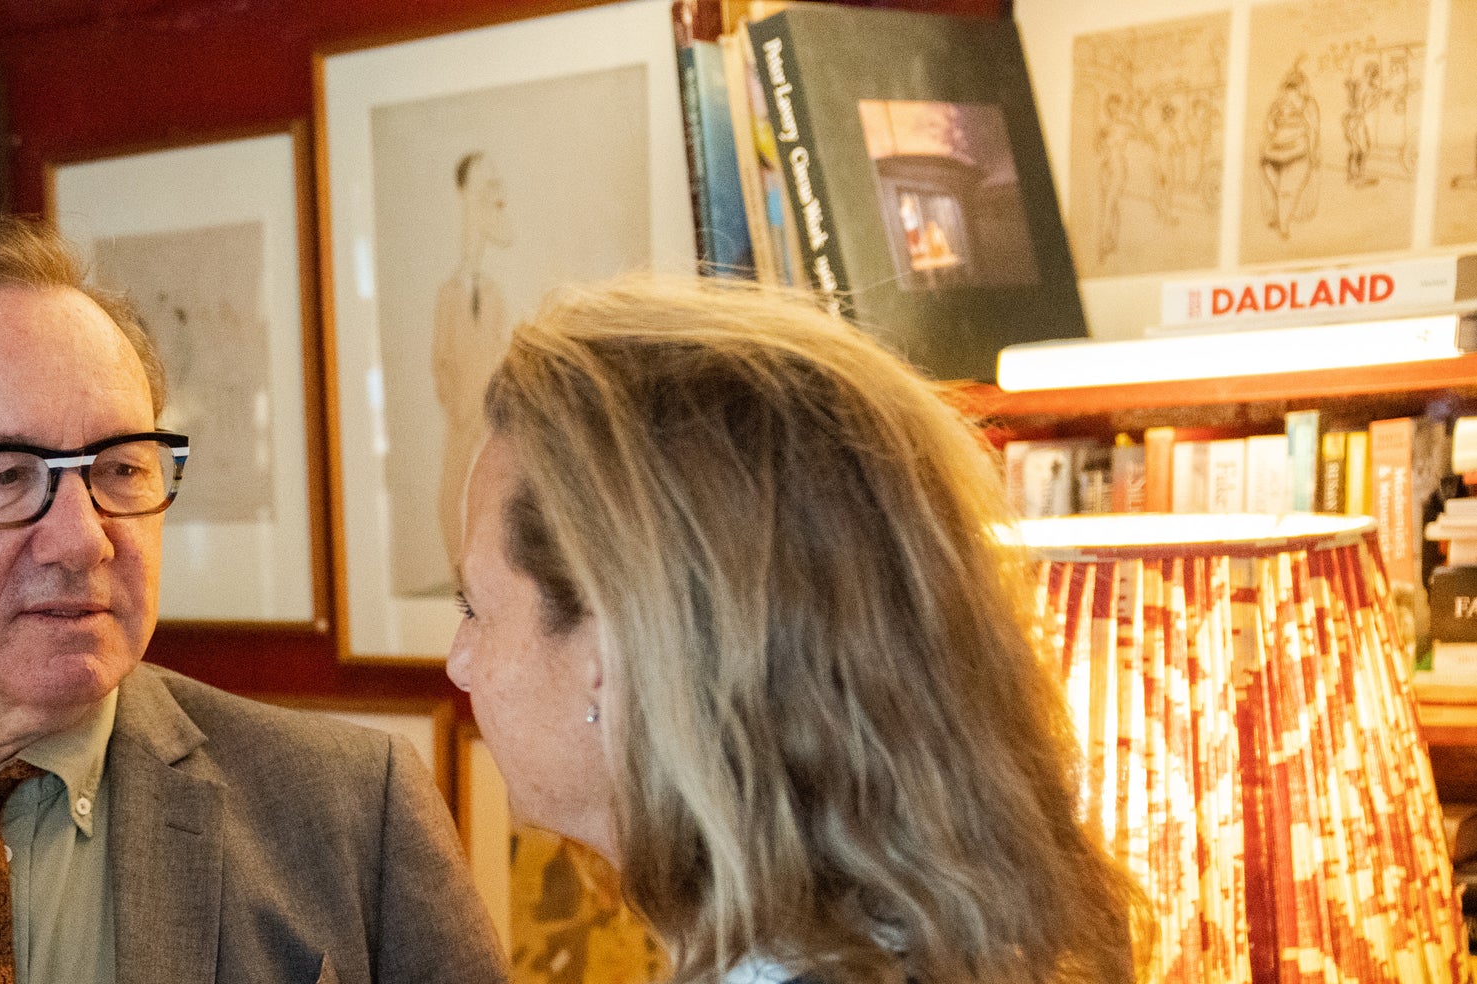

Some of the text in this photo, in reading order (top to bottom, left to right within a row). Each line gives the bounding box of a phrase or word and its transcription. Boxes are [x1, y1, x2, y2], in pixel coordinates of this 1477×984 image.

[763, 36, 787, 86] Peter
[773, 83, 799, 142] Lavery
[1210, 273, 1395, 316] DADLAND
